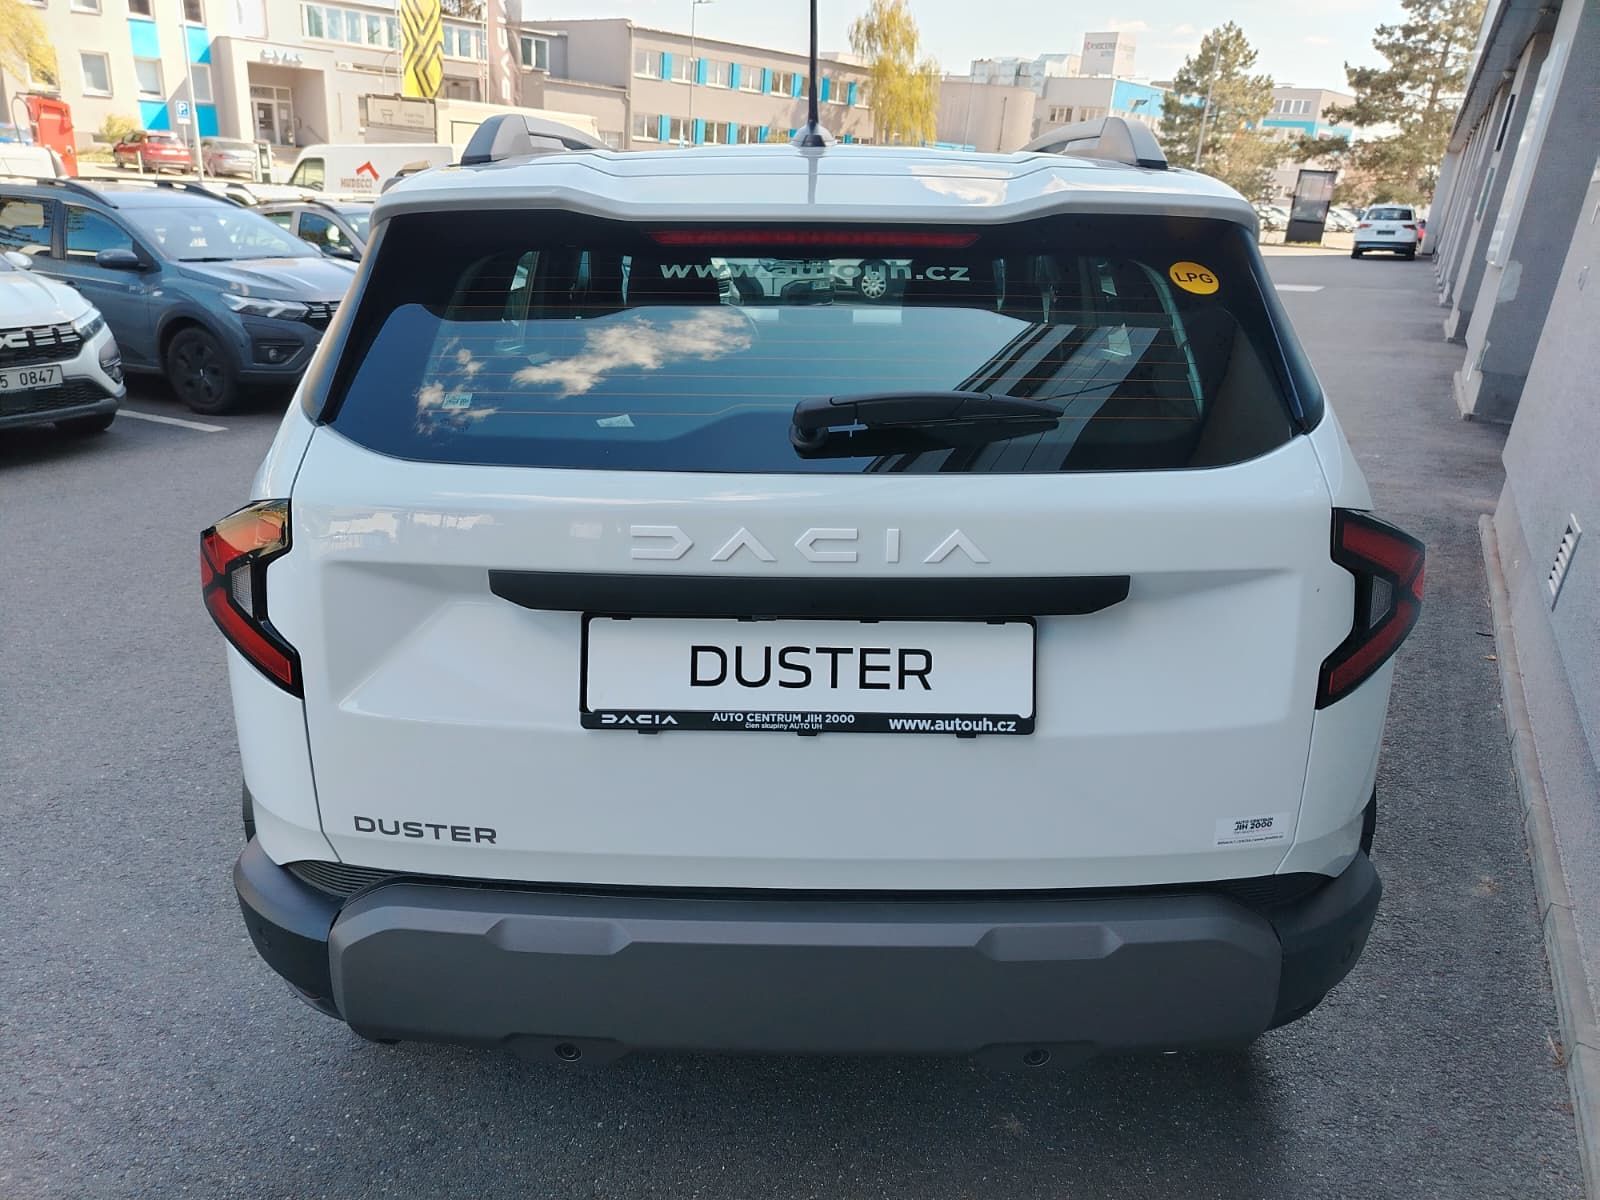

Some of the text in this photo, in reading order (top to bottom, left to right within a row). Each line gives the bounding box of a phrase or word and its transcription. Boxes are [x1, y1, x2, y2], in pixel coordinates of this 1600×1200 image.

[1175, 271, 1213, 284] LPG
[19, 369, 54, 386] 0847
[630, 524, 991, 564] DACIA
[689, 645, 933, 691] DUSTER
[601, 714, 679, 725] DACIA
[712, 713, 855, 724] AUTO CENTRUM JIH 2000
[889, 718, 1017, 732] www.autouh.cz
[761, 723, 788, 731] skupiny
[354, 816, 497, 844] DUSTER
[1234, 823, 1248, 831] JIH
[1249, 821, 1273, 829] 2000
